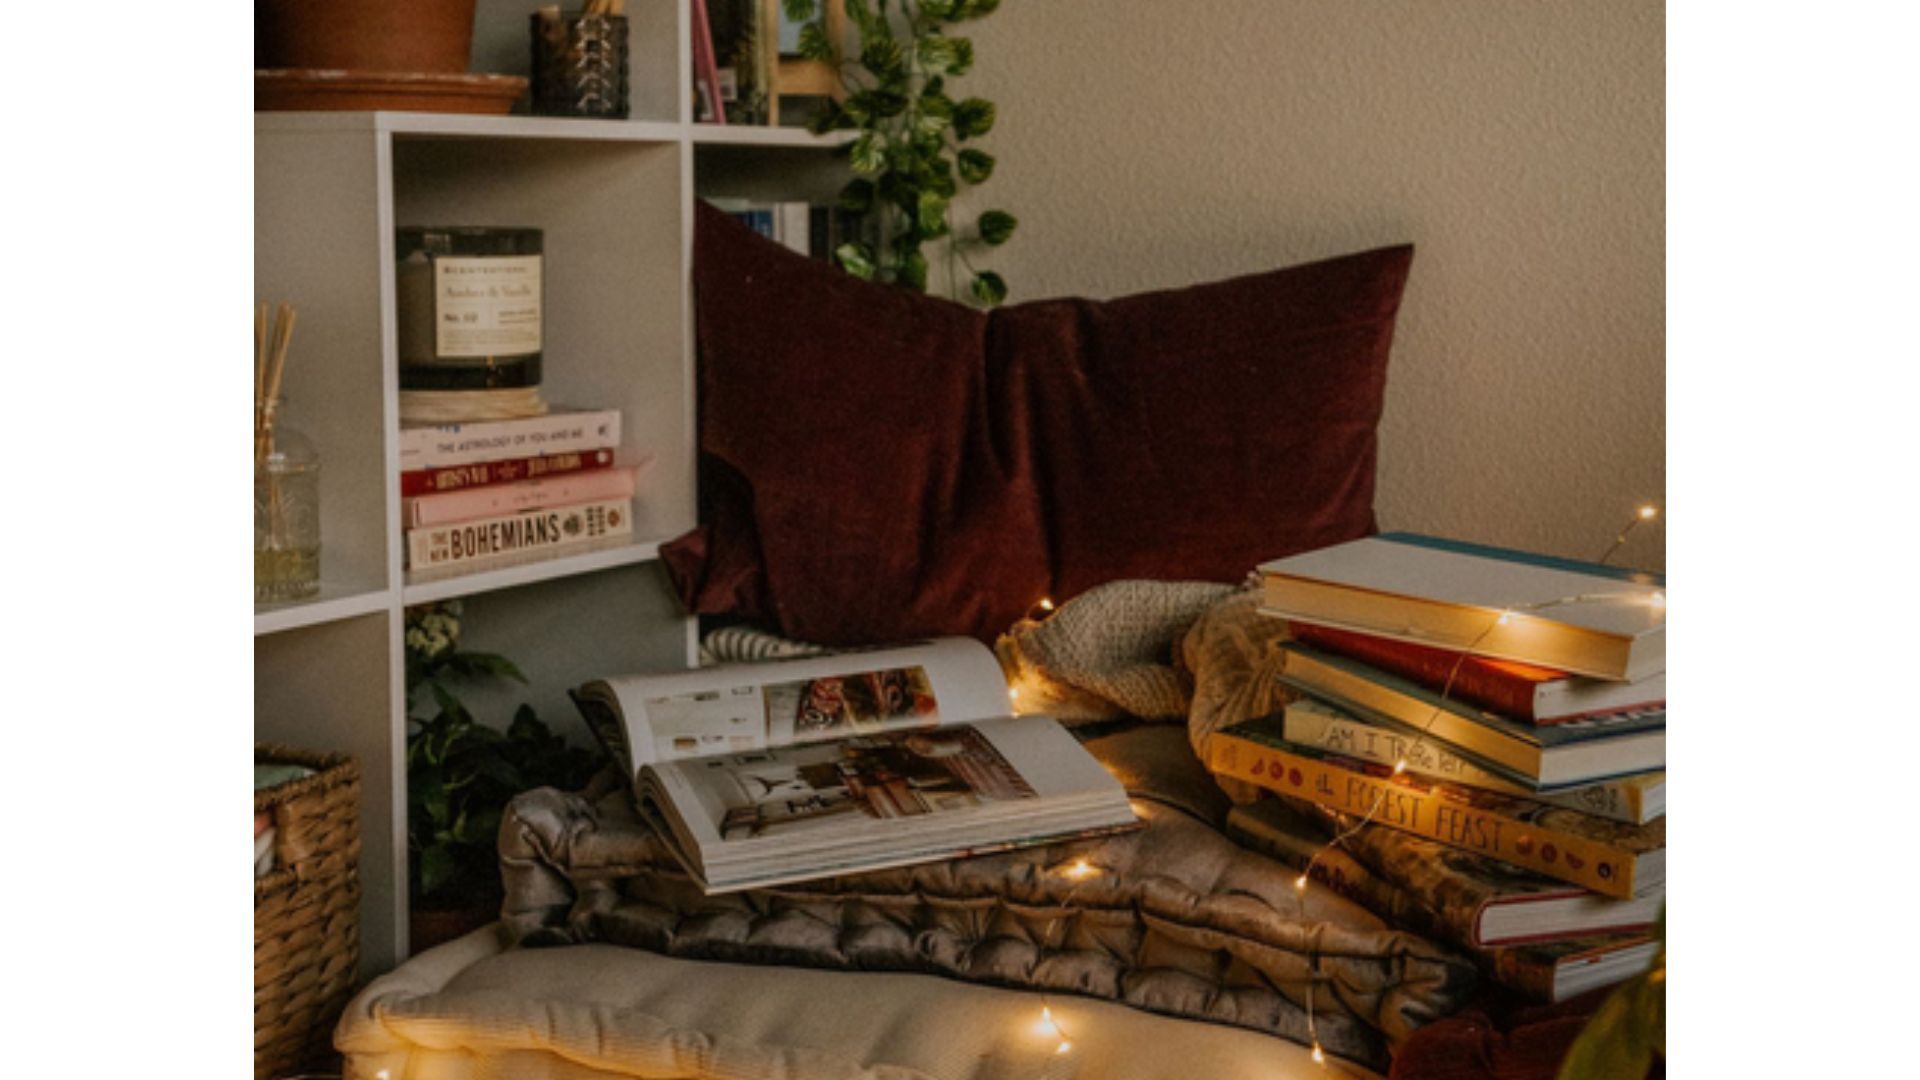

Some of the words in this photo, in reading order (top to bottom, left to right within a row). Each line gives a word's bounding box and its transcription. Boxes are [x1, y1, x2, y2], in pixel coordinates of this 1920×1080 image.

[458, 435, 512, 451] ASTROLOGY
[513, 434, 526, 446] OF
[530, 432, 546, 443] YOU
[450, 513, 560, 560] BOHEMIANS
[1346, 775, 1421, 830] FOREST
[1436, 804, 1502, 852] FEAST
